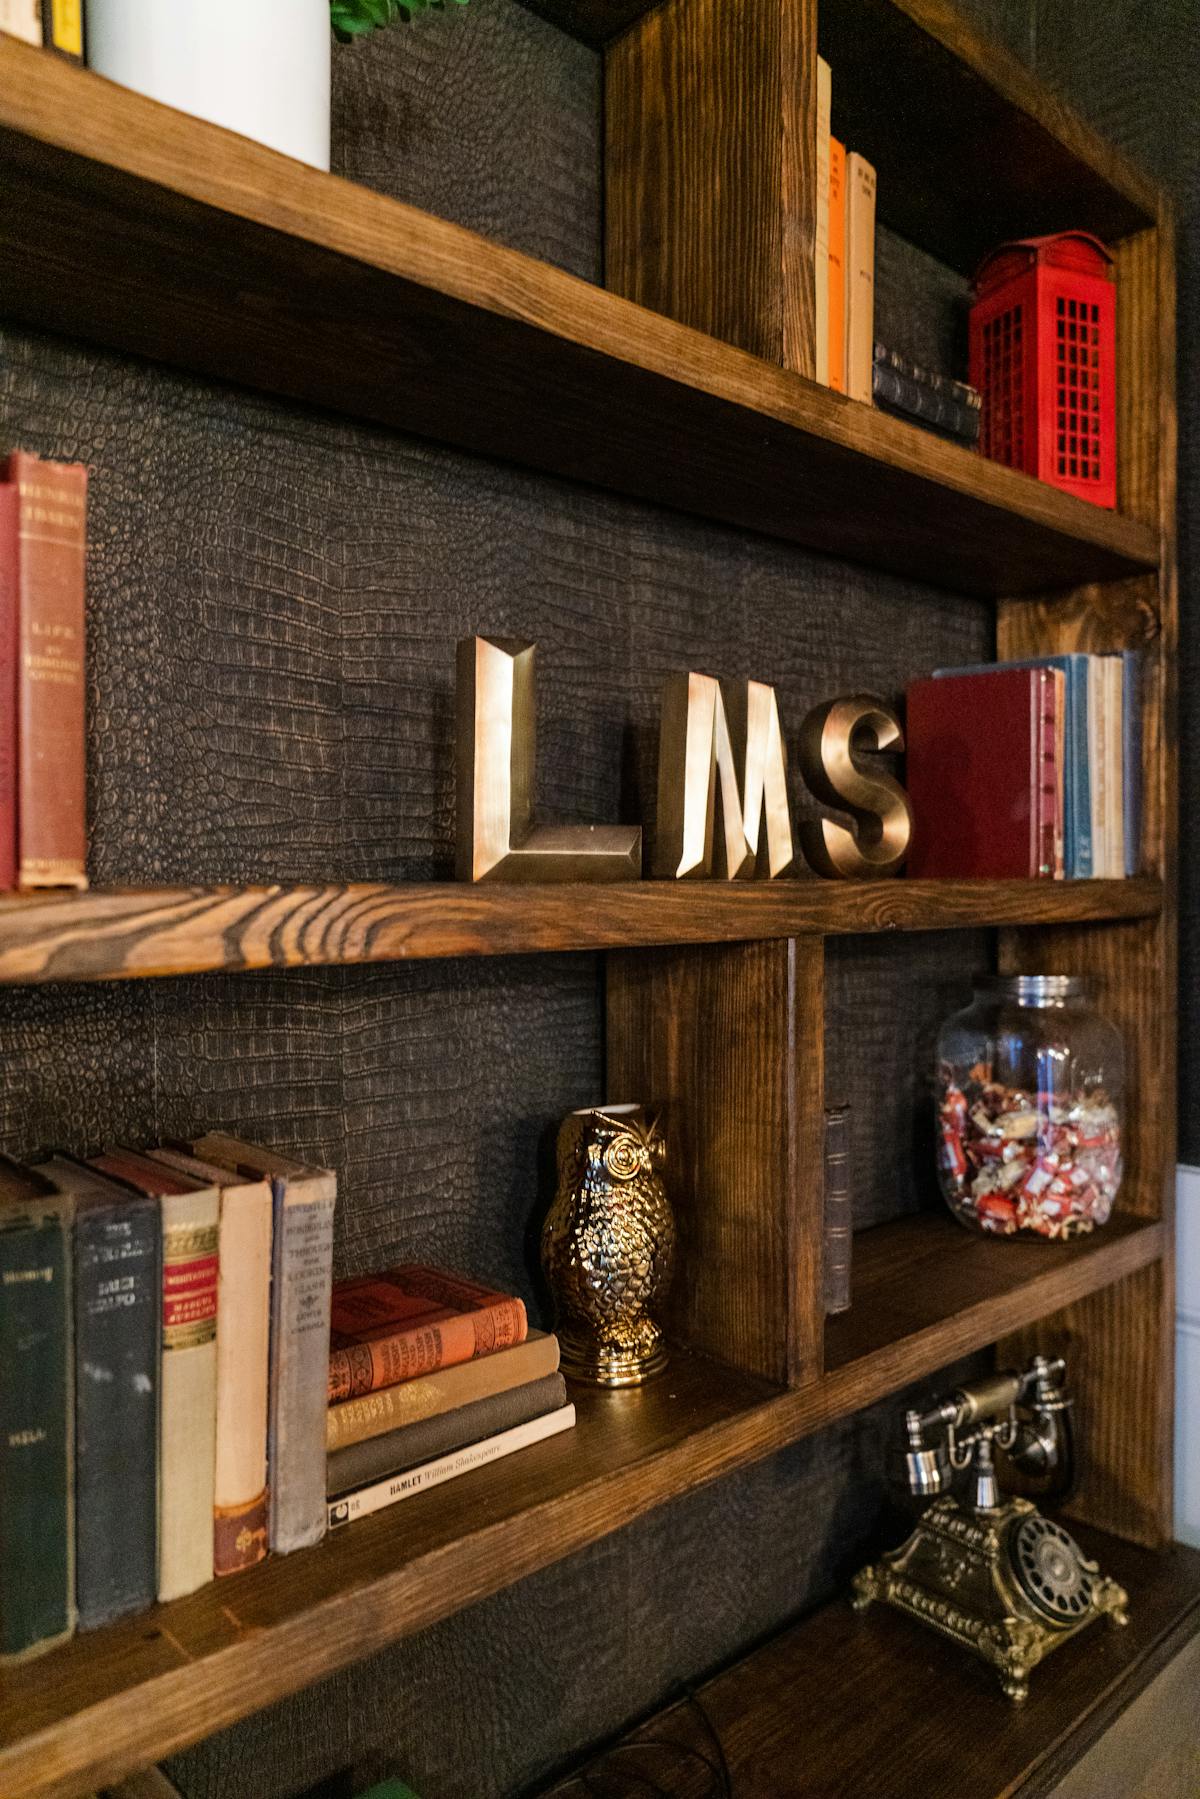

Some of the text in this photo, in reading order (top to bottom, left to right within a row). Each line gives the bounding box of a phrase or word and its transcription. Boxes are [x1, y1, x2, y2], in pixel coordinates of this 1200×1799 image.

[32, 621, 75, 639] LIFE
[390, 1474, 423, 1496] HAMLET
[424, 1464, 454, 1482] William
